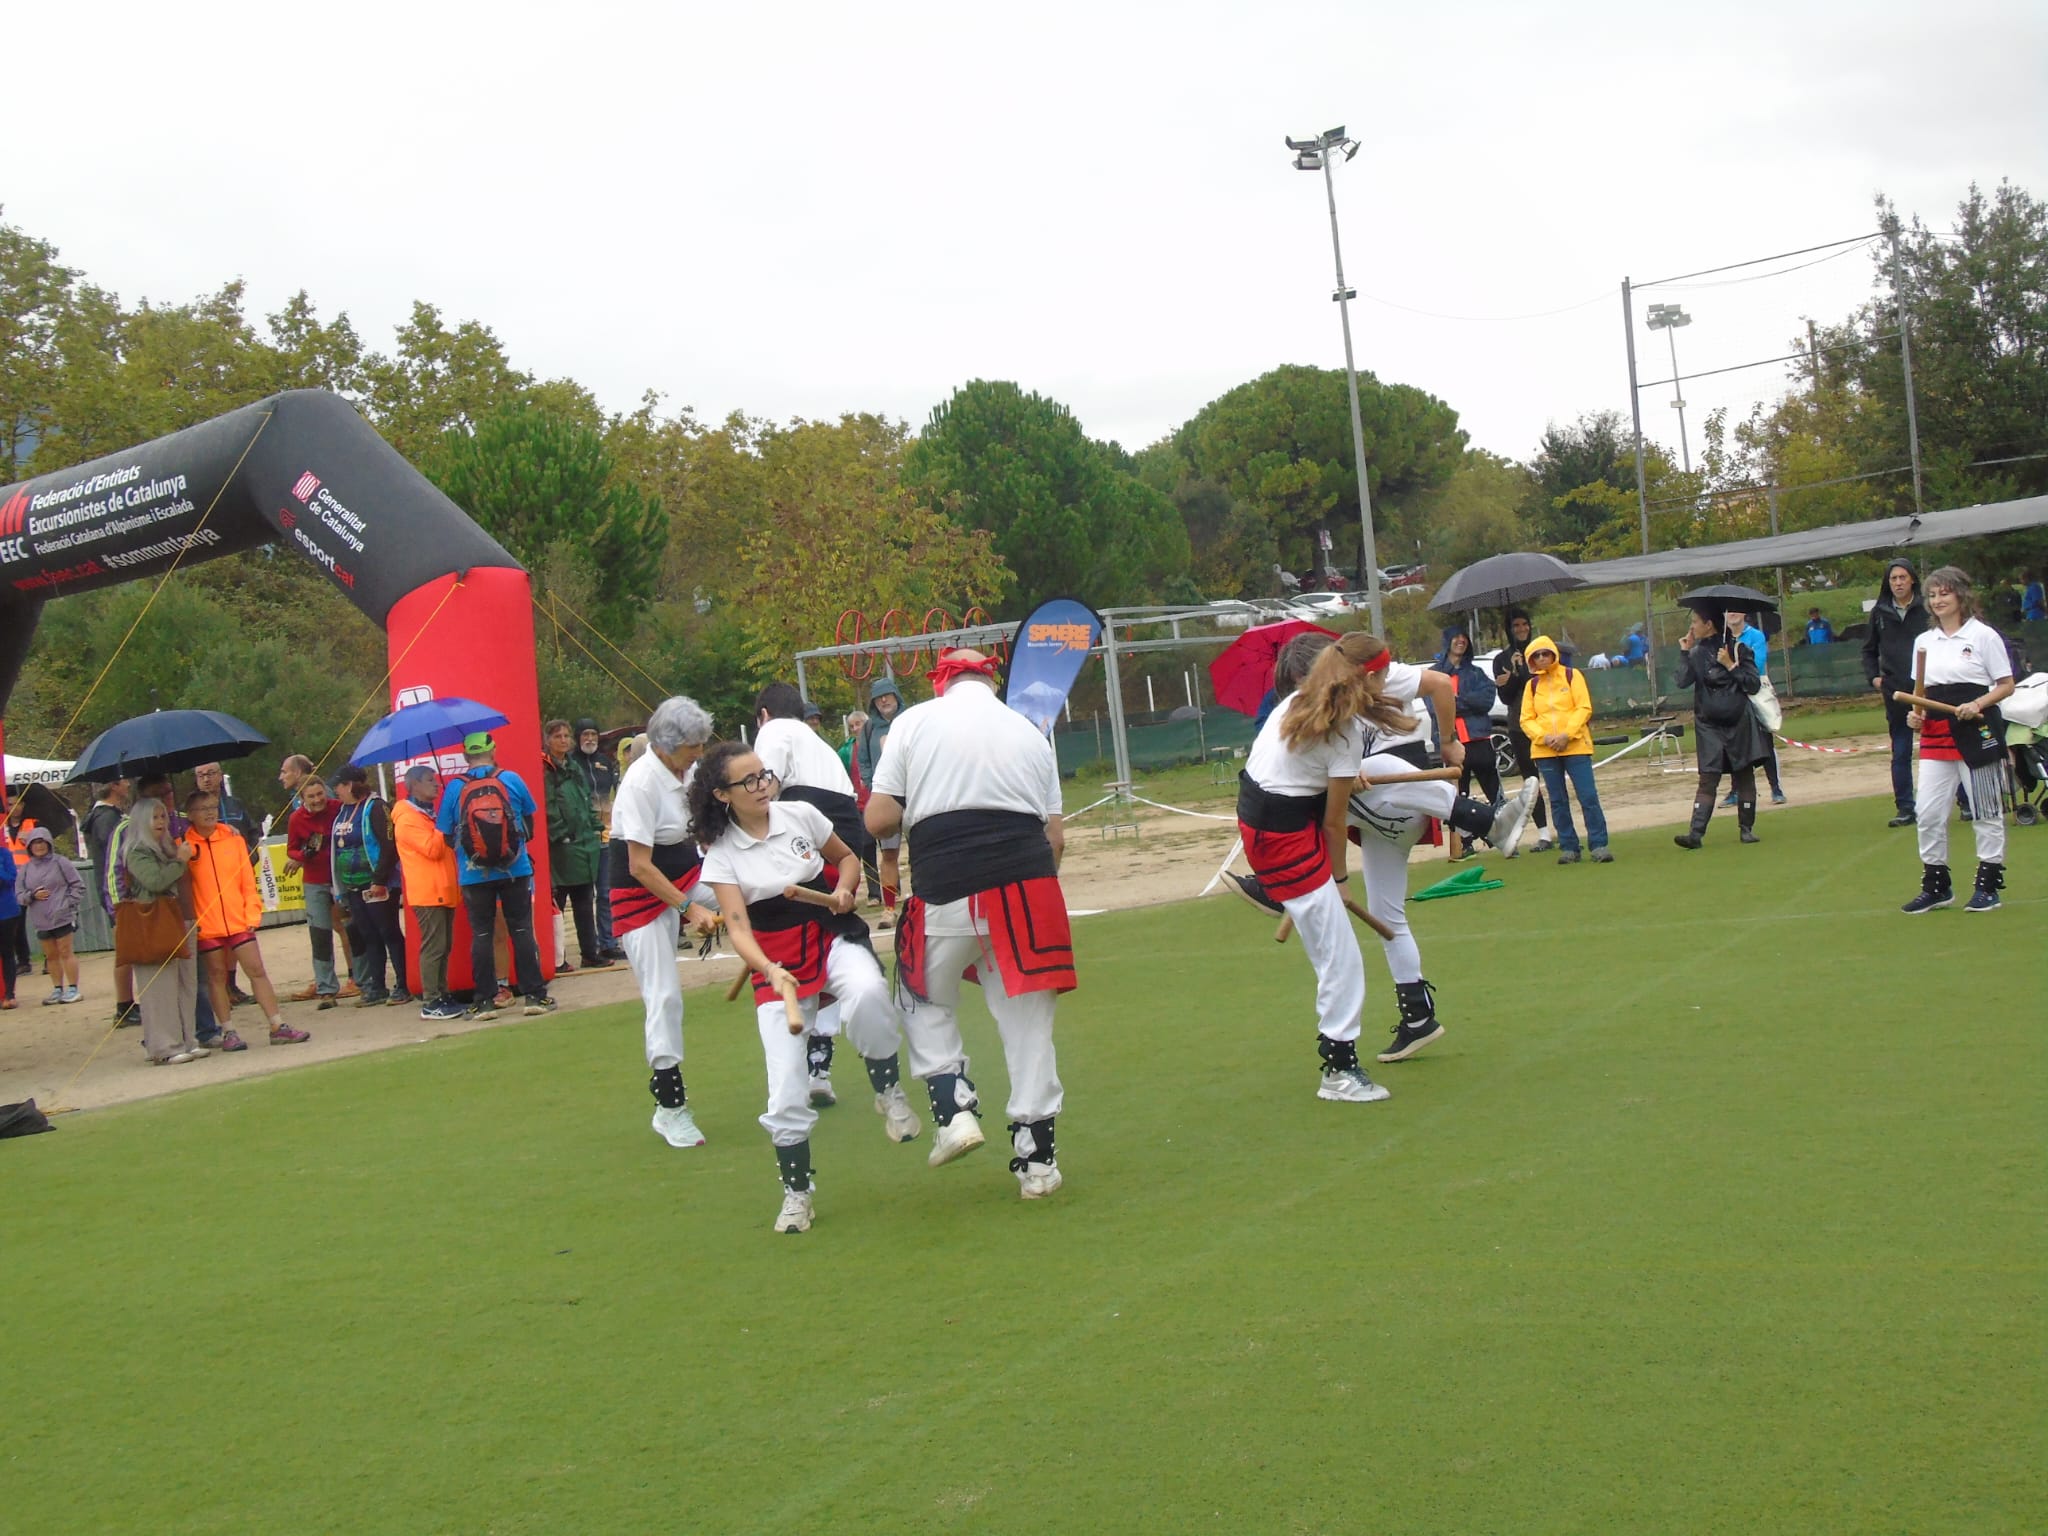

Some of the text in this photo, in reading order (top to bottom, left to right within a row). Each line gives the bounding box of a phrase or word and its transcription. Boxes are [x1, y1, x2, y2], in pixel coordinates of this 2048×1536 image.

[29, 474, 187, 535] Excursionistes de Catalunya
[30, 464, 142, 512] Federació d'Entitats
[317, 487, 367, 533] Generalitat
[34, 530, 73, 555] Federació
[71, 526, 104, 546] Catalana
[105, 513, 152, 537] d'Alpinisme
[156, 499, 195, 520] Escalada
[101, 528, 222, 569] #sommuntanya
[308, 501, 365, 553] de Catalunya
[294, 528, 355, 590] esportcat
[1028, 624, 1091, 641] SPHERE
